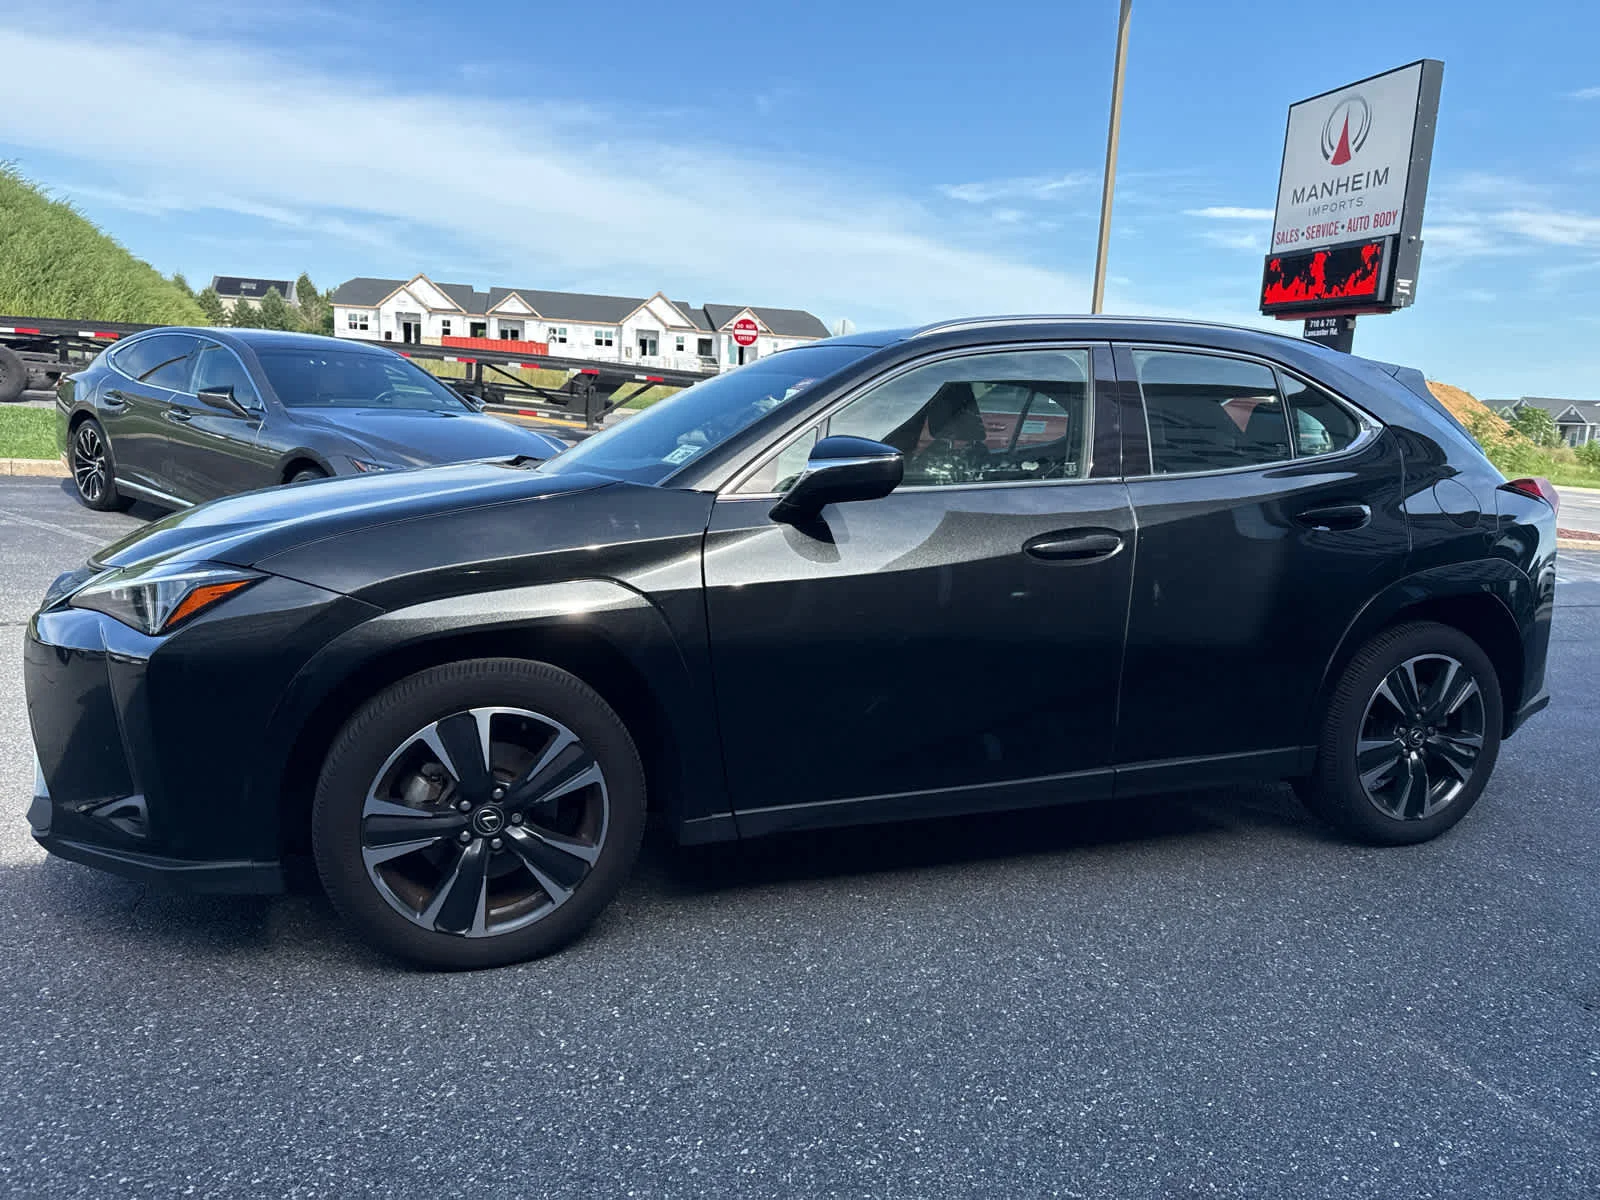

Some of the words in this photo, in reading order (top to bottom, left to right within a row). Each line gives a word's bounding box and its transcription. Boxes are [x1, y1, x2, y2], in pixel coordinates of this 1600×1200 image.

[1291, 167, 1390, 205] MANHEIM
[1308, 197, 1364, 216] IMPORTS
[1275, 229, 1300, 245] SALES
[1305, 221, 1340, 240] SERVICE
[1346, 215, 1370, 233] AUTO
[1373, 210, 1398, 228] BODY
